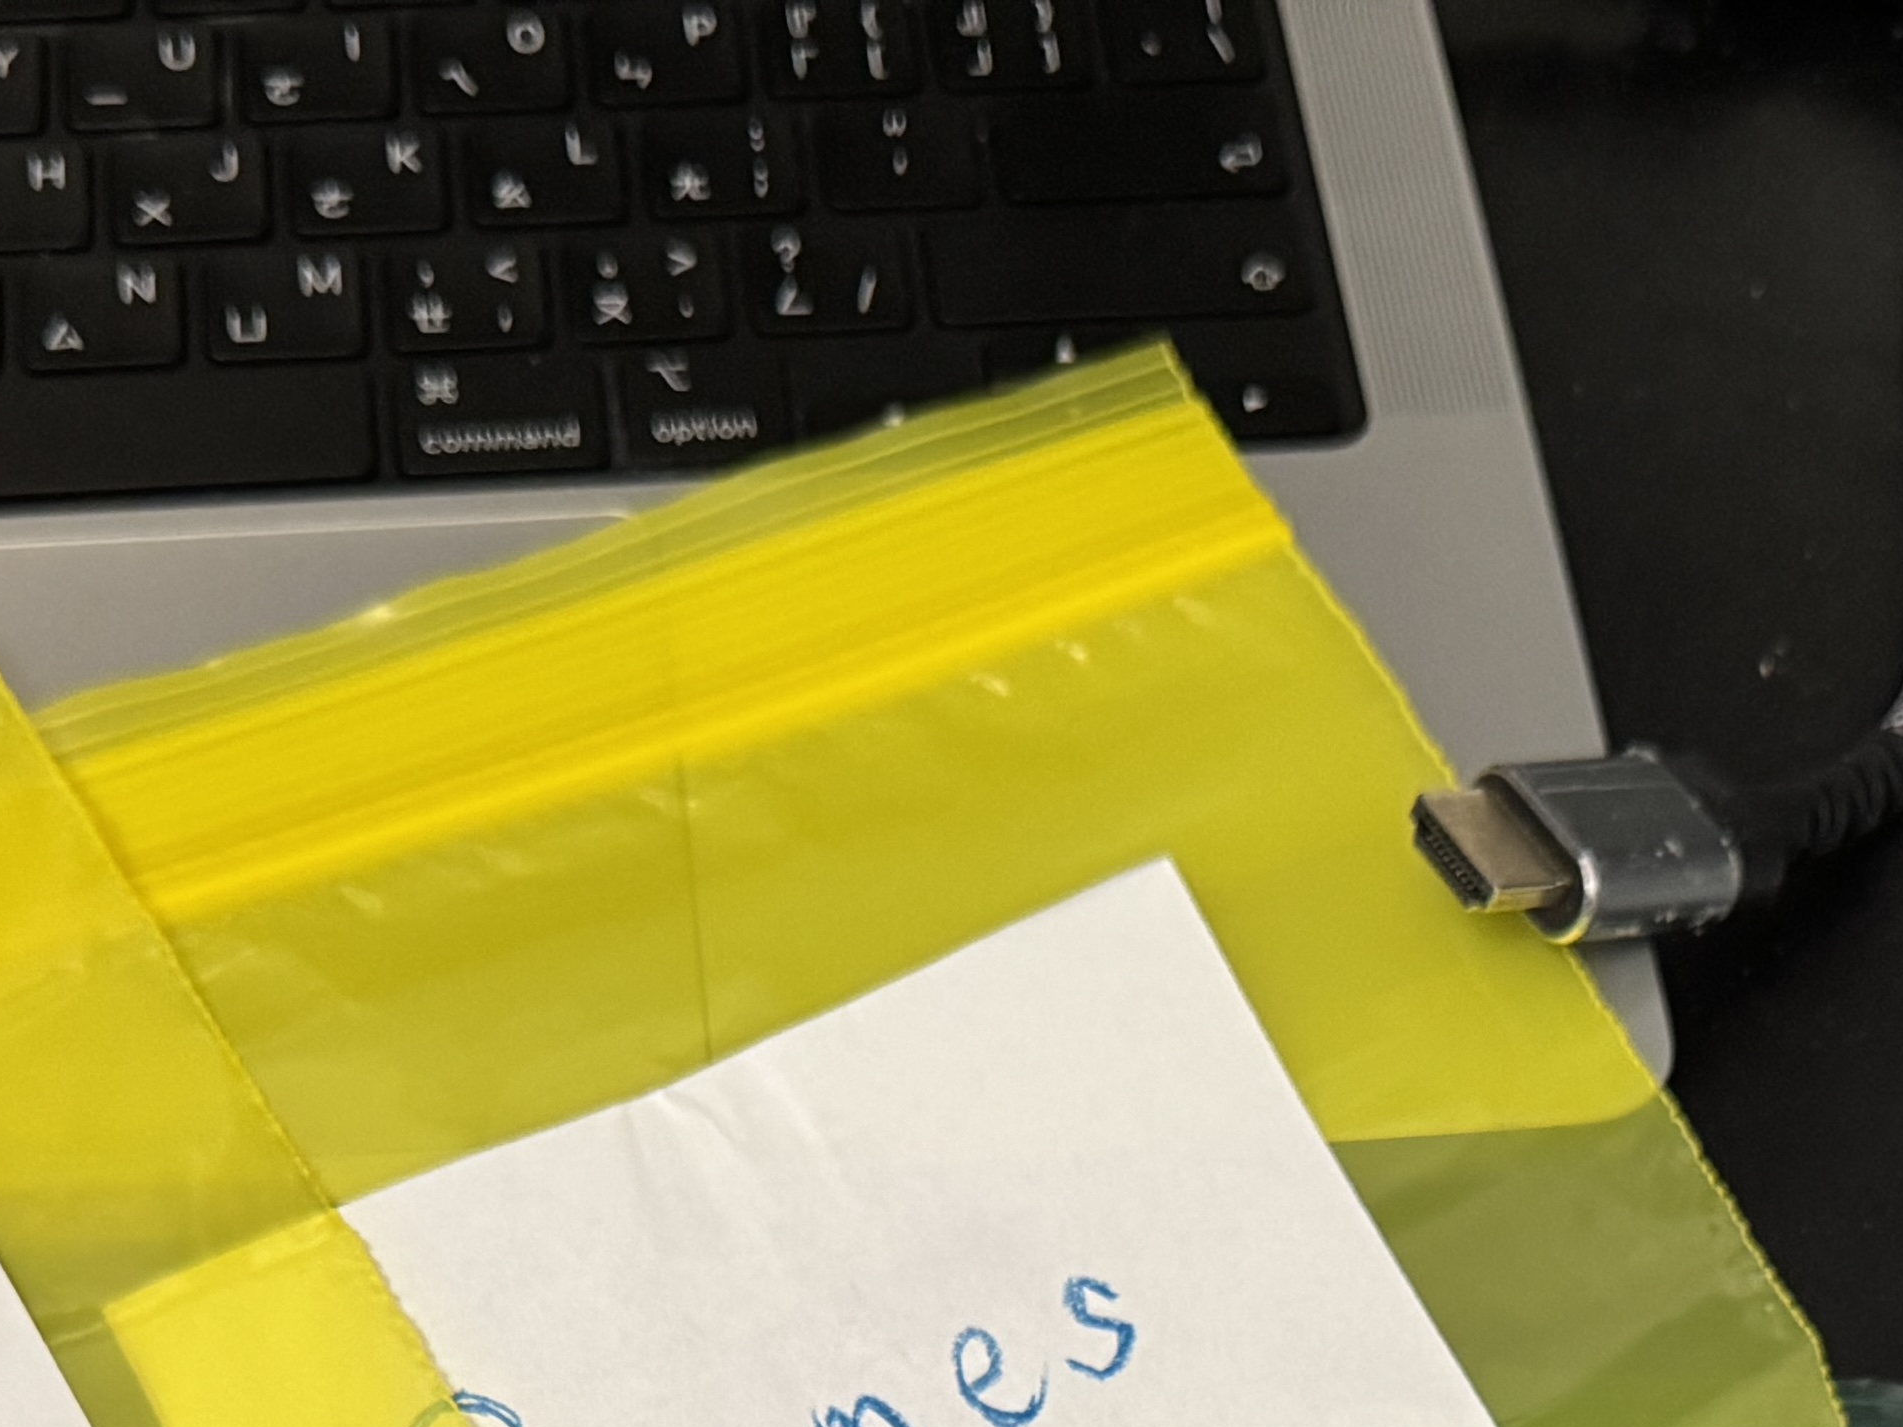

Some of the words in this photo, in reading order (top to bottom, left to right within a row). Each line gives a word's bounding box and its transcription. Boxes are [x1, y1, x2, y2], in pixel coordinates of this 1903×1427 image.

[506, 18, 545, 54] O
[681, 11, 717, 46] P
[158, 35, 196, 71] U
[211, 145, 239, 182] J
[385, 138, 420, 173] K
[564, 129, 595, 166] L
[27, 155, 66, 191] H
[118, 269, 156, 304] N
[298, 259, 343, 296] M
[418, 419, 581, 455] command
[650, 412, 758, 446] option
